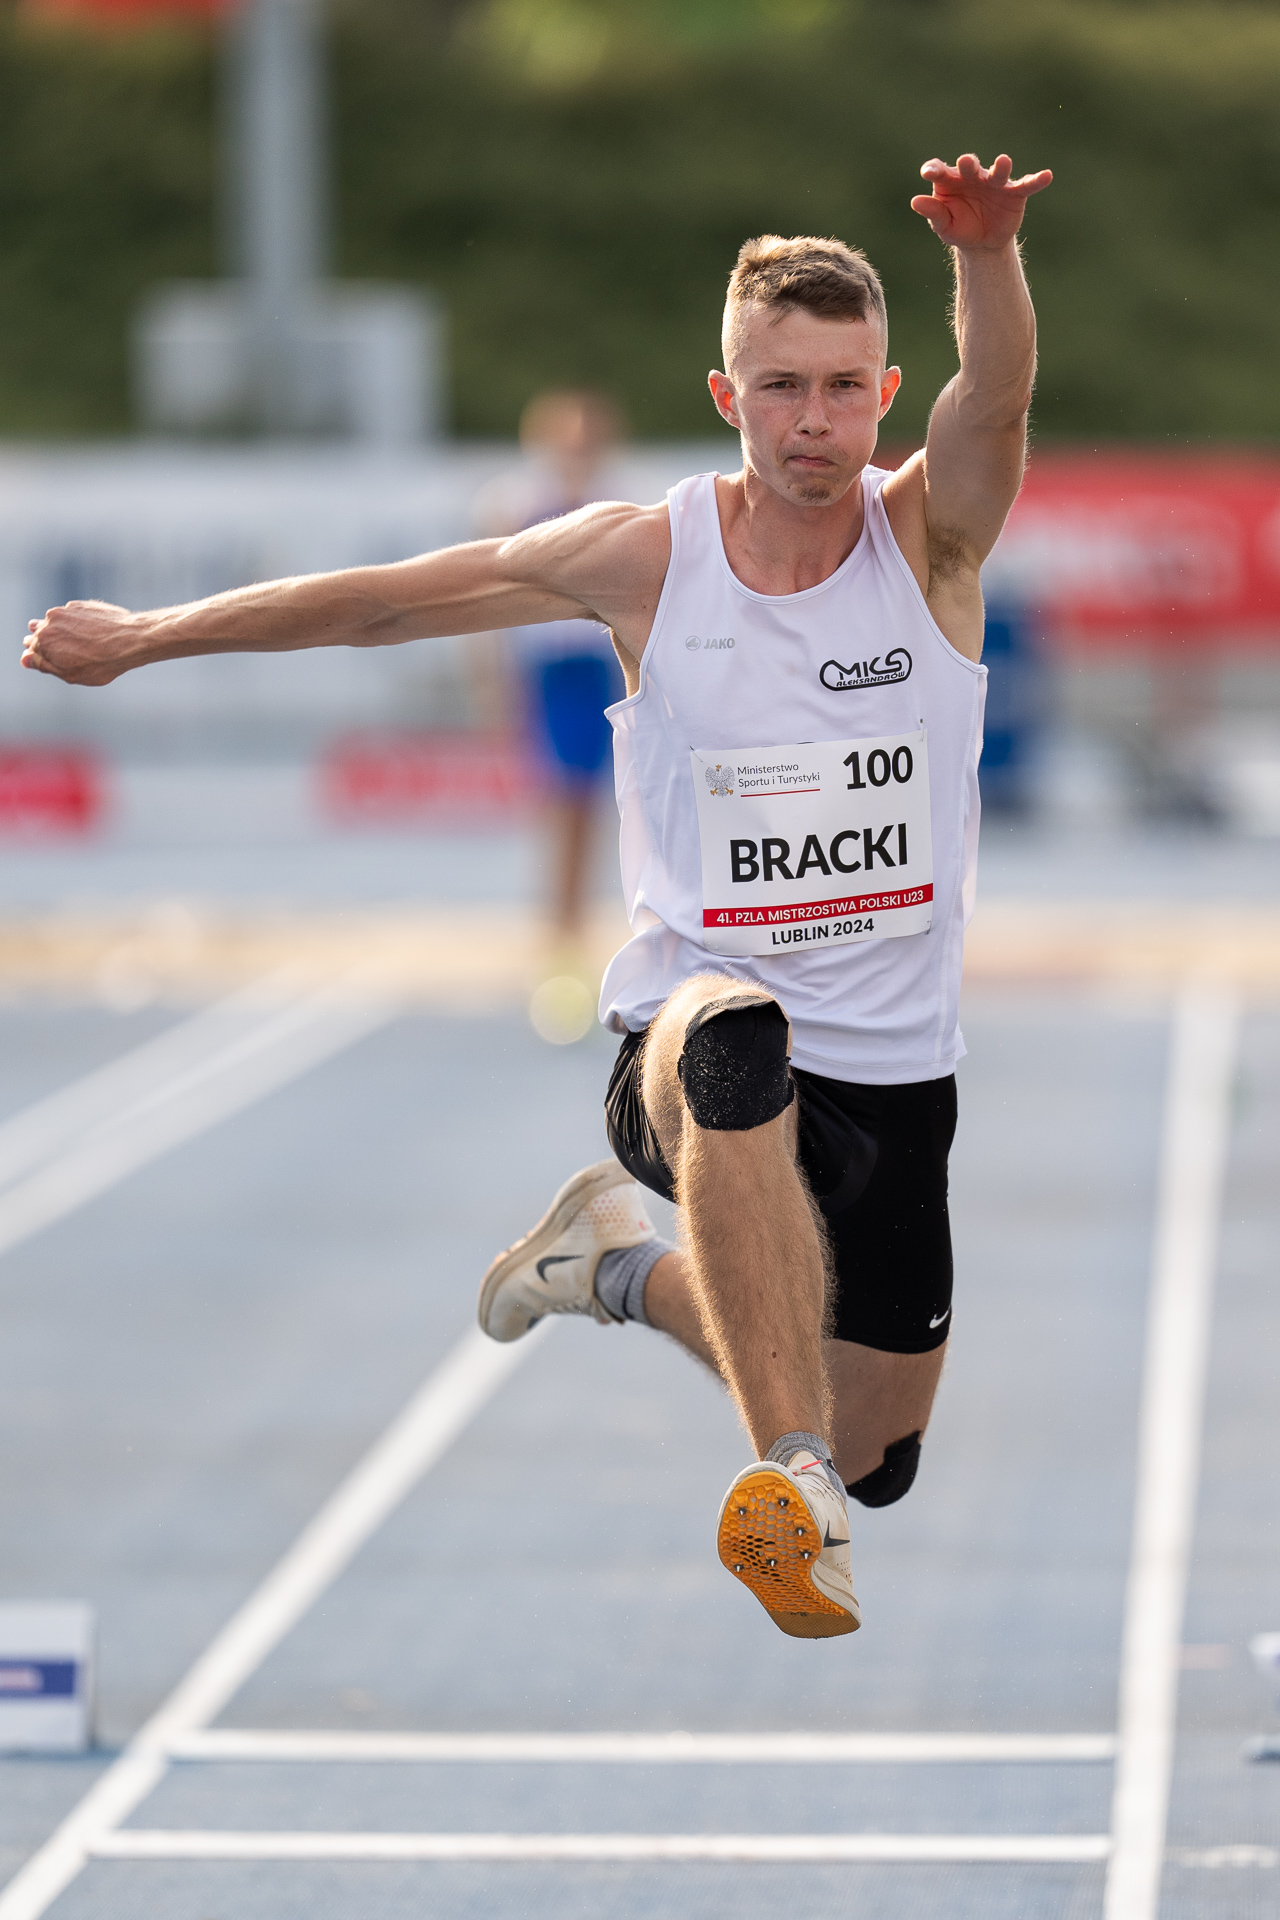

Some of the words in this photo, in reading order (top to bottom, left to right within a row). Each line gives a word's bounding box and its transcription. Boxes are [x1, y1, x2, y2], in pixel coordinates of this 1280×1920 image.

[704, 637, 735, 650] JAKO
[836, 671, 906, 687] ALEKSANDRÓW
[737, 762, 799, 774] Ministerstwo
[843, 745, 913, 790] 100
[738, 776, 770, 789] Sportu
[778, 771, 820, 784] Turystyki
[730, 823, 908, 883] BRACKI
[717, 912, 733, 924] 41.
[736, 909, 765, 923] PZLA
[768, 900, 857, 922] MISTRZOSTWA
[859, 894, 901, 908] POLSKI
[903, 890, 924, 904] U23
[772, 927, 829, 945] LUBLIN
[833, 918, 874, 937] 2024
